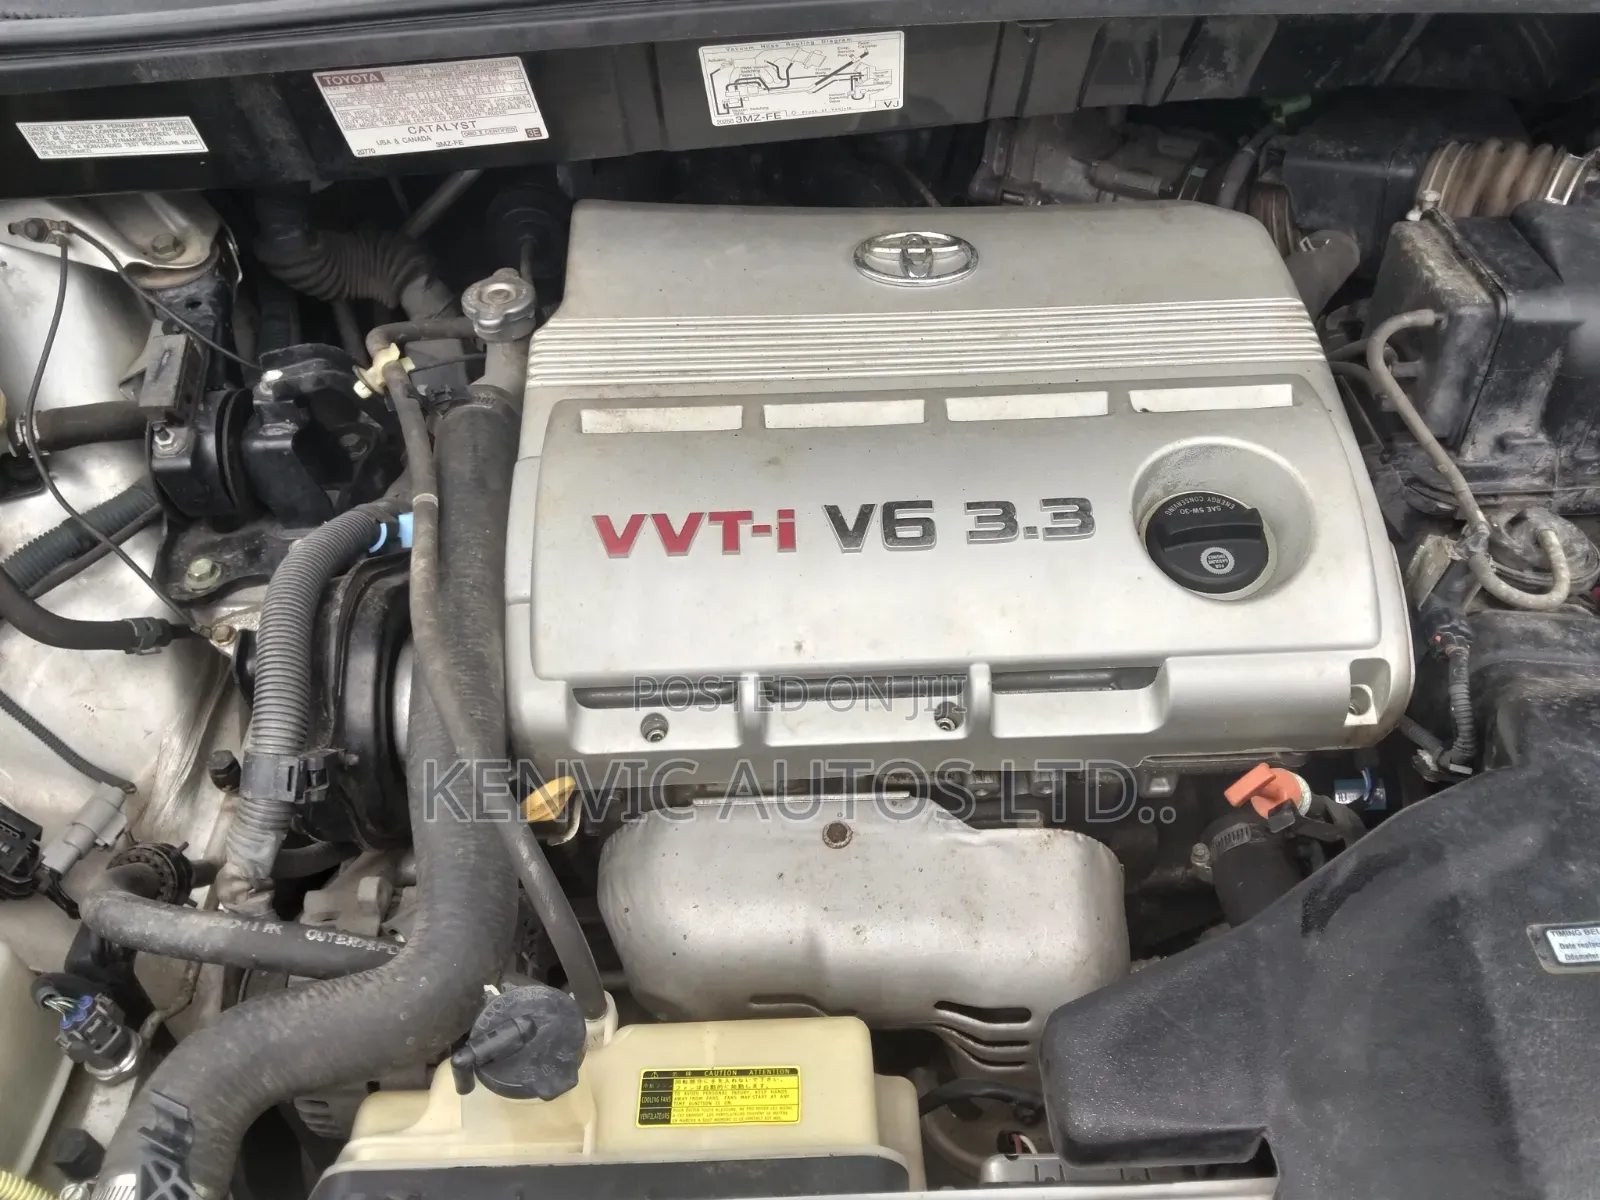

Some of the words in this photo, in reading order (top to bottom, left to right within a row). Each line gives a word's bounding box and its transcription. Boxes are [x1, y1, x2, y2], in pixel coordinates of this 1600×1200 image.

[322, 73, 380, 86] TOYOTA
[884, 100, 899, 108] VJ
[736, 112, 781, 123] 3MZ-FE
[408, 121, 476, 135] CATALYST
[527, 128, 541, 137] 3E
[402, 135, 432, 143] CANADA
[436, 140, 464, 148] 3MZ-FE
[1165, 496, 1204, 516] CONSERVING
[1207, 496, 1236, 510] ENERGY
[1180, 506, 1205, 515] 5W-30
[1207, 505, 1222, 513] SAE
[591, 509, 797, 559] VVT-i
[821, 499, 937, 554] V6
[966, 497, 1097, 545] 3.3
[1551, 929, 1582, 937] TIMING
[641, 1096, 660, 1104] COOLING
[661, 1095, 672, 1103] FANS
[640, 1112, 670, 1120] VENTILATEURS
